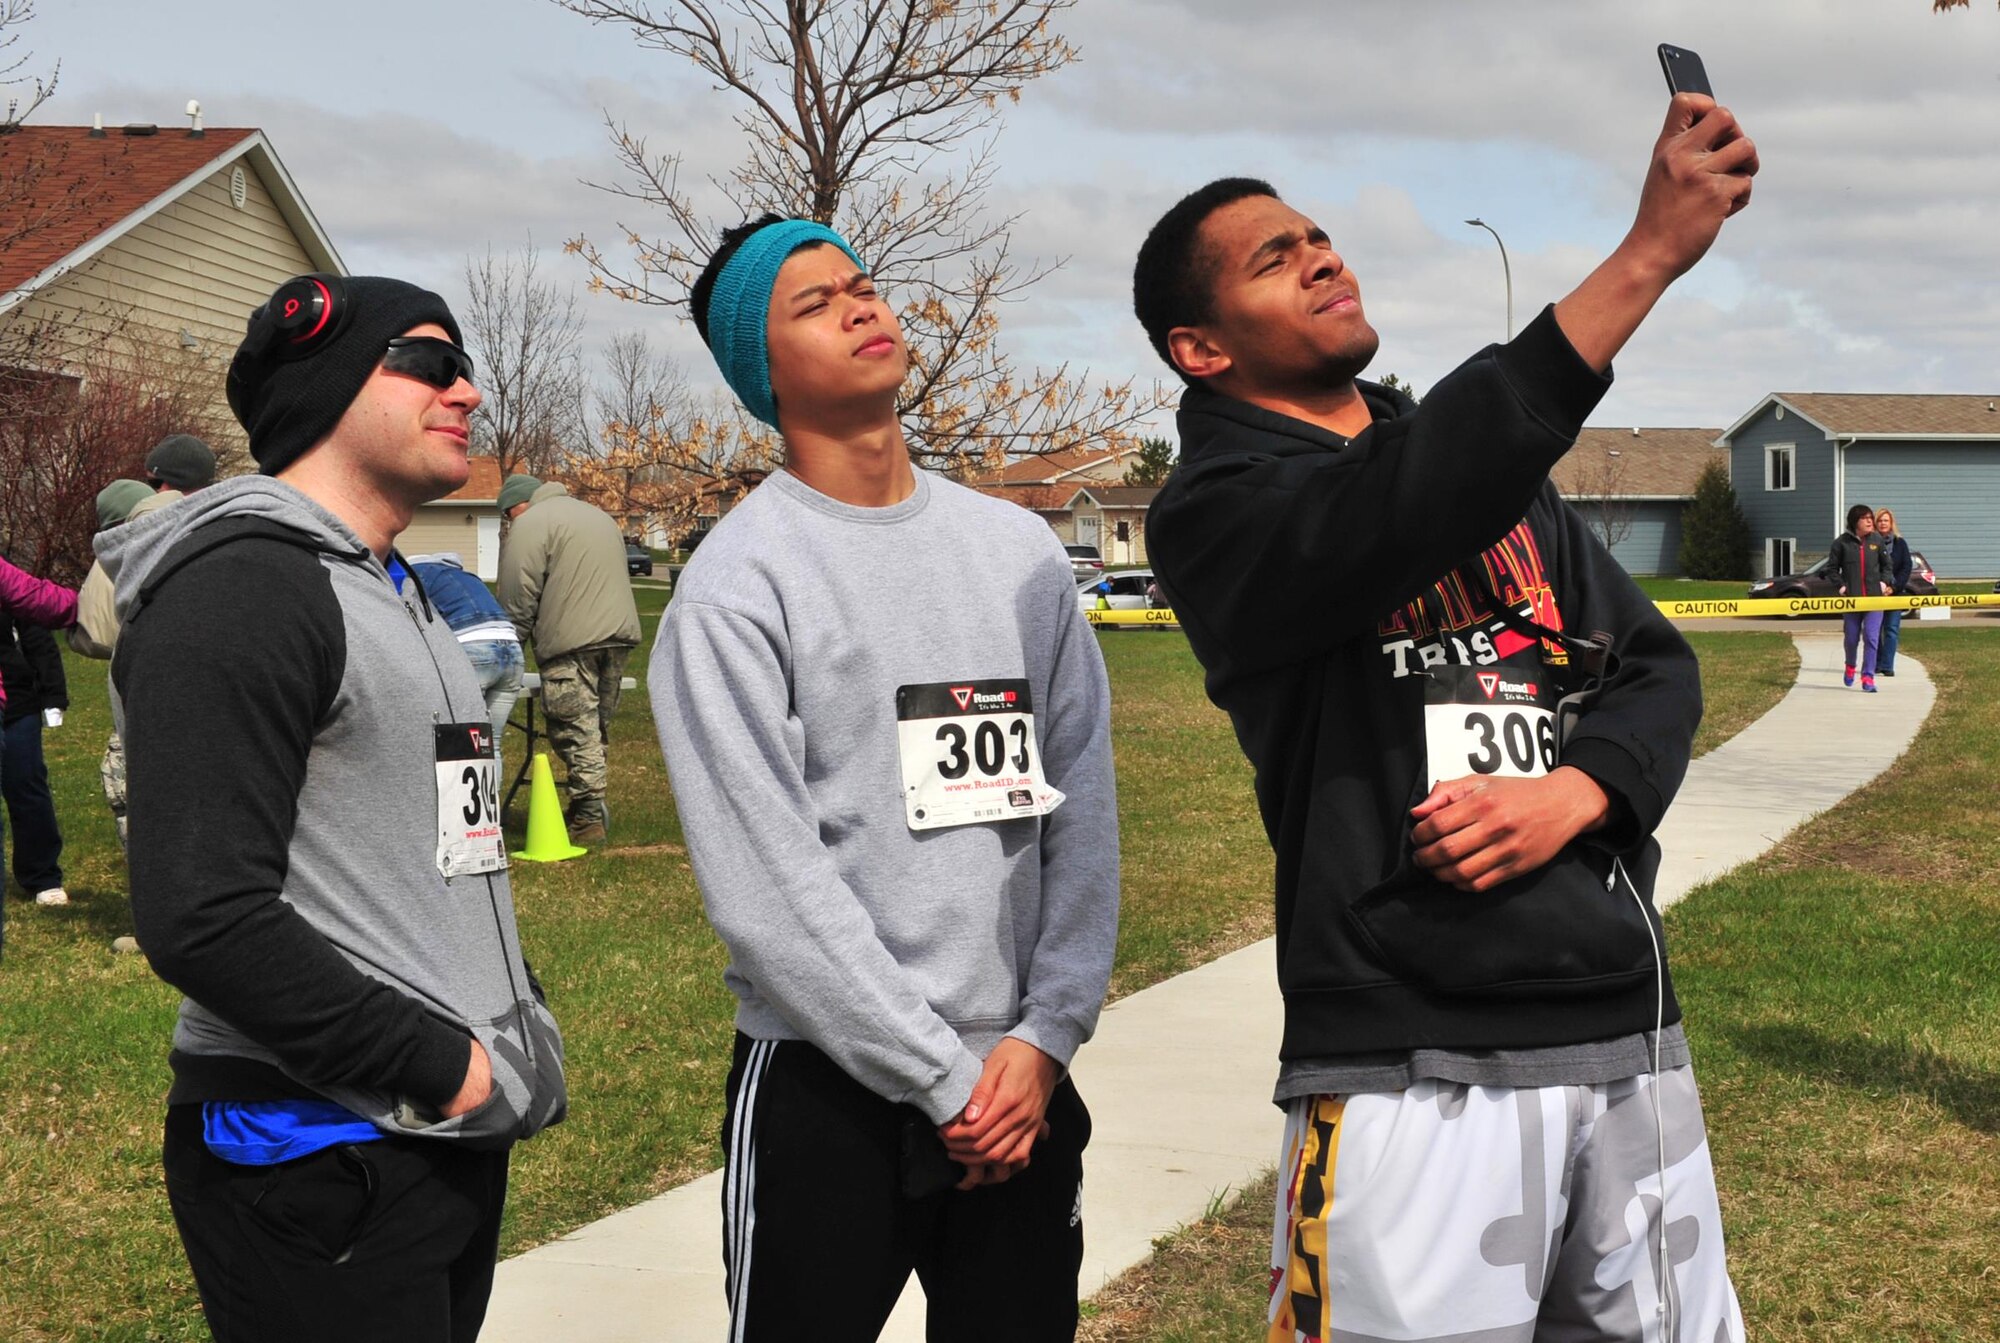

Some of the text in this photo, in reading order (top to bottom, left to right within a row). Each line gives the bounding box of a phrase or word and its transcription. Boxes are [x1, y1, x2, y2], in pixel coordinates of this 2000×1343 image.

[1674, 601, 1738, 614] CAUTION
[1790, 598, 1856, 611] CAUTION
[1909, 596, 1978, 607] CAUTION
[1145, 610, 1177, 621] CAU
[973, 691, 1017, 704] RoadID
[935, 718, 1030, 780] 303
[1464, 711, 1555, 775] 306
[943, 777, 1033, 793] www.RoadID.om
